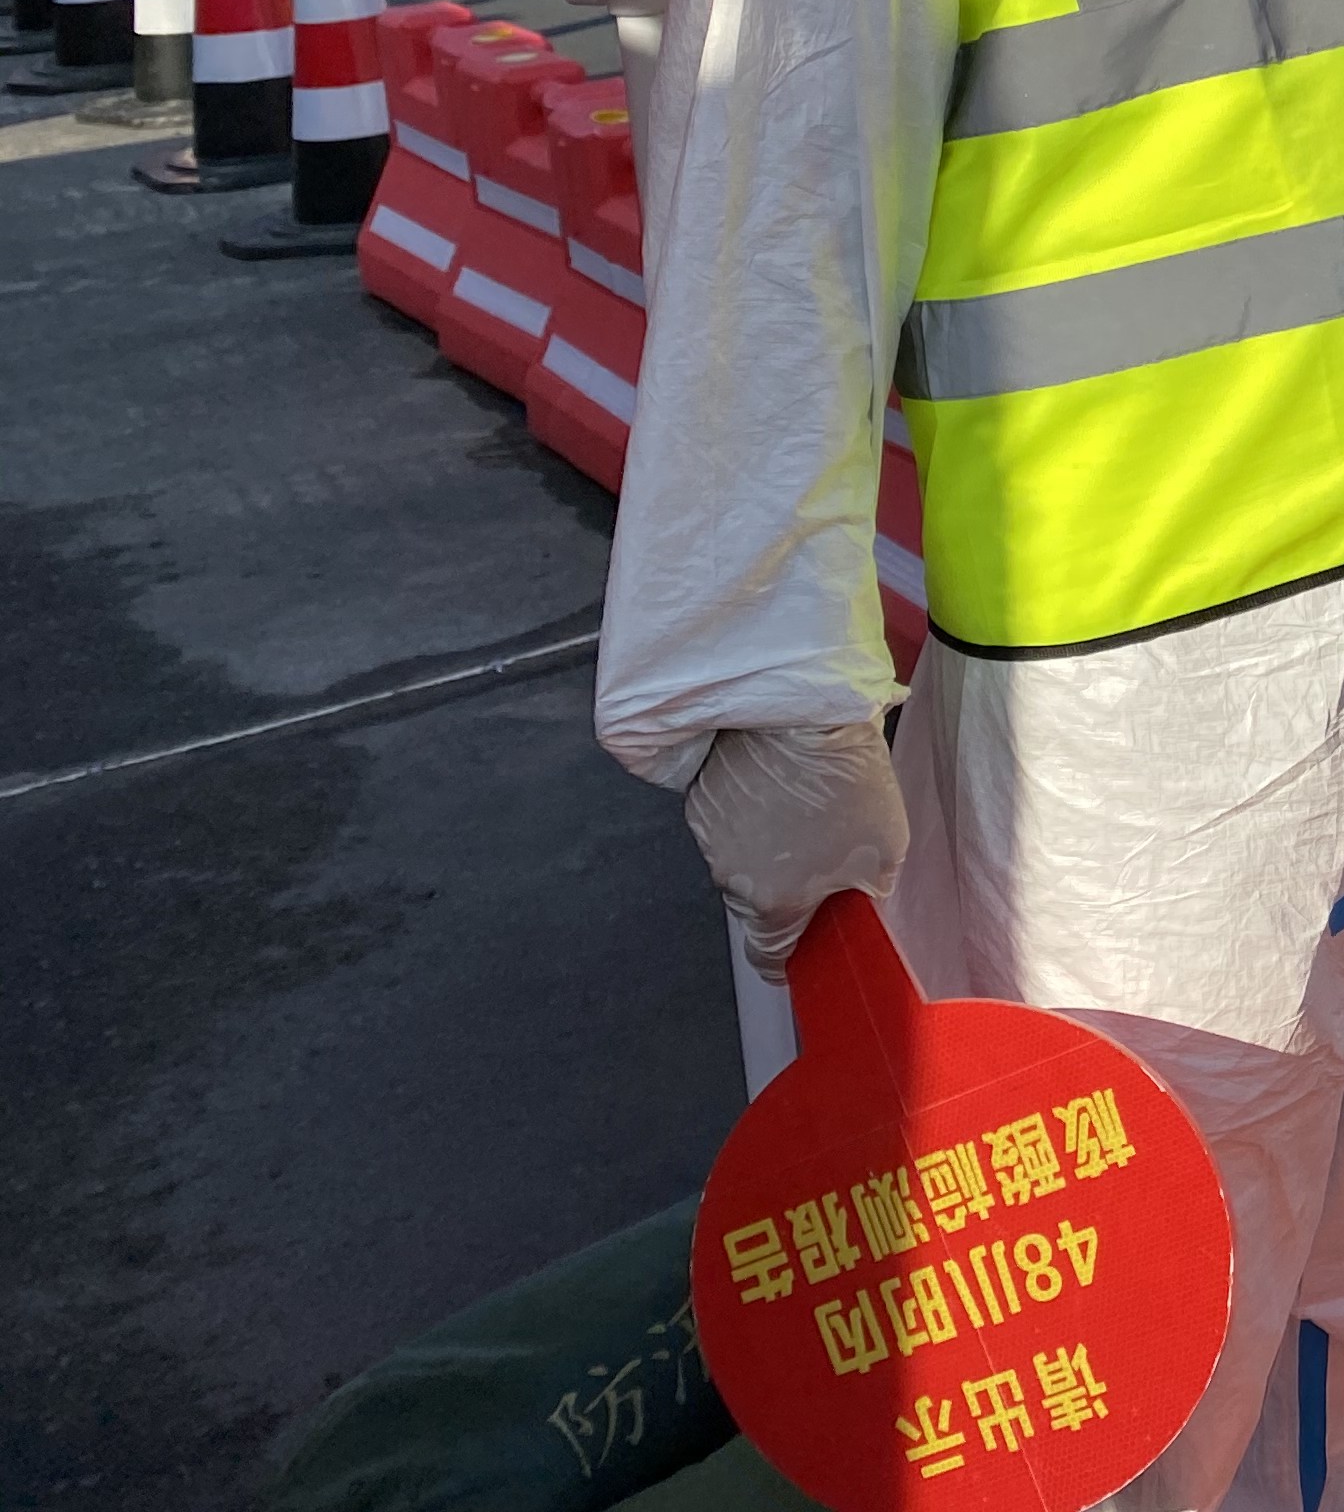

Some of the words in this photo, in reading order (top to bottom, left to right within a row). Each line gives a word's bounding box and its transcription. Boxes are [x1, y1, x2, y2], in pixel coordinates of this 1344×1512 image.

[722, 1087, 1136, 1304] 核酸检测报告
[814, 1220, 1099, 1376] 48小时内
[896, 1344, 1109, 1479] 请出示
